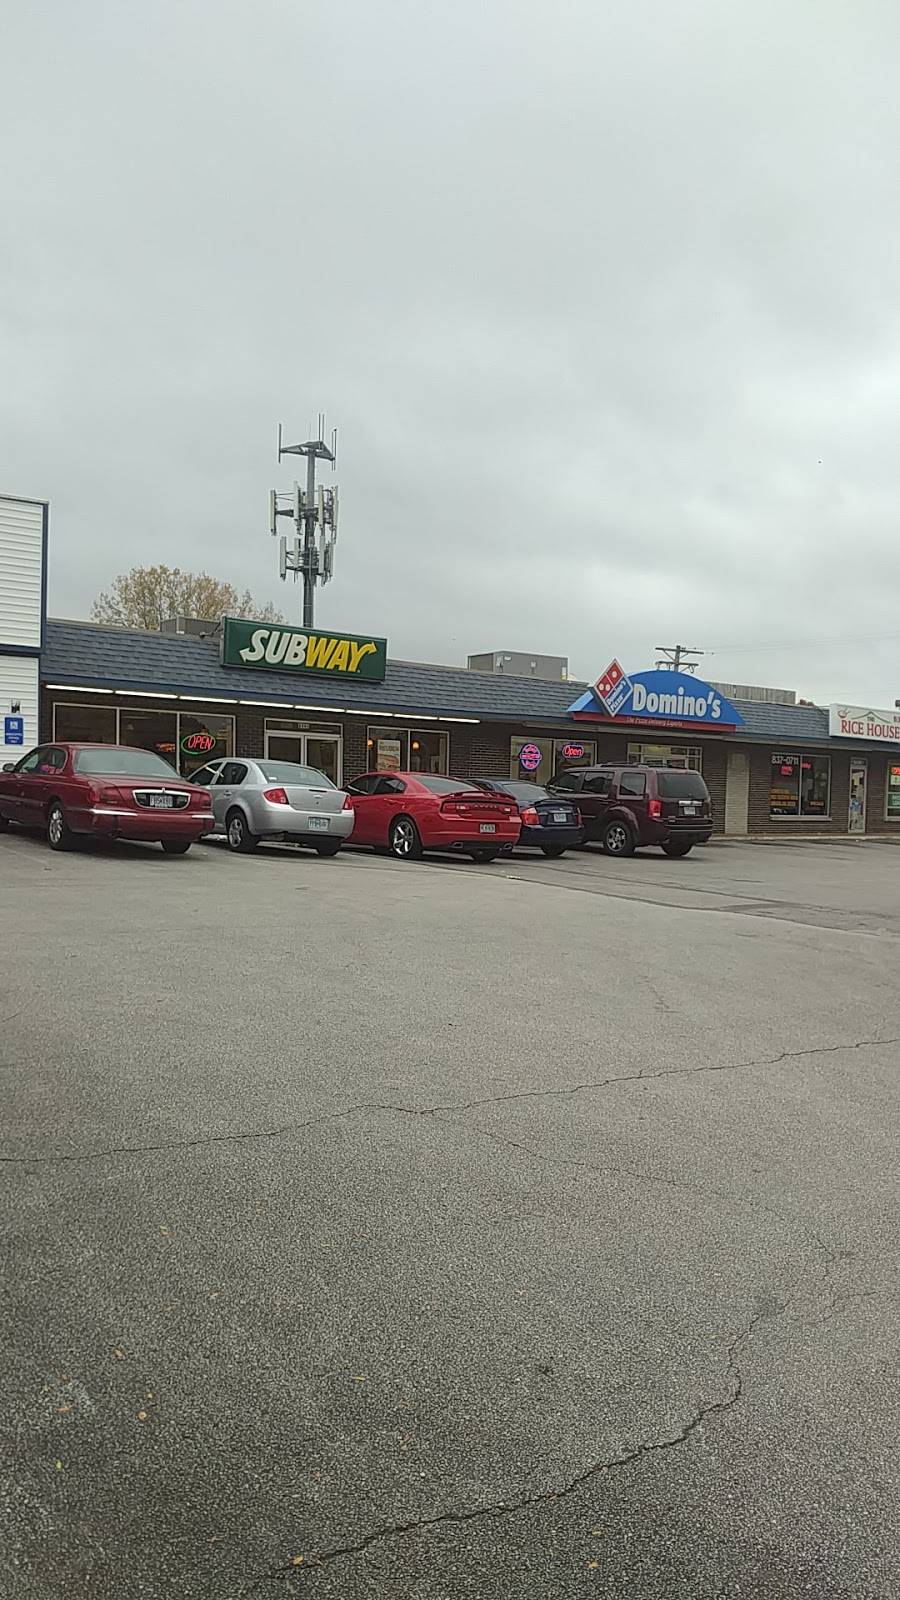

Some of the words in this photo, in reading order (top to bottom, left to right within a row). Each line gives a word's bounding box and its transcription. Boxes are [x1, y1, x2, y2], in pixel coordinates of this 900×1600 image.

[239, 629, 377, 673] SUBWAY
[632, 683, 721, 718] Domino's
[841, 719, 864, 735] RICE
[867, 722, 900, 739] HOUSE
[187, 735, 213, 750] OPEN
[564, 745, 582, 757] Open
[771, 755, 799, 765] 837-0711
